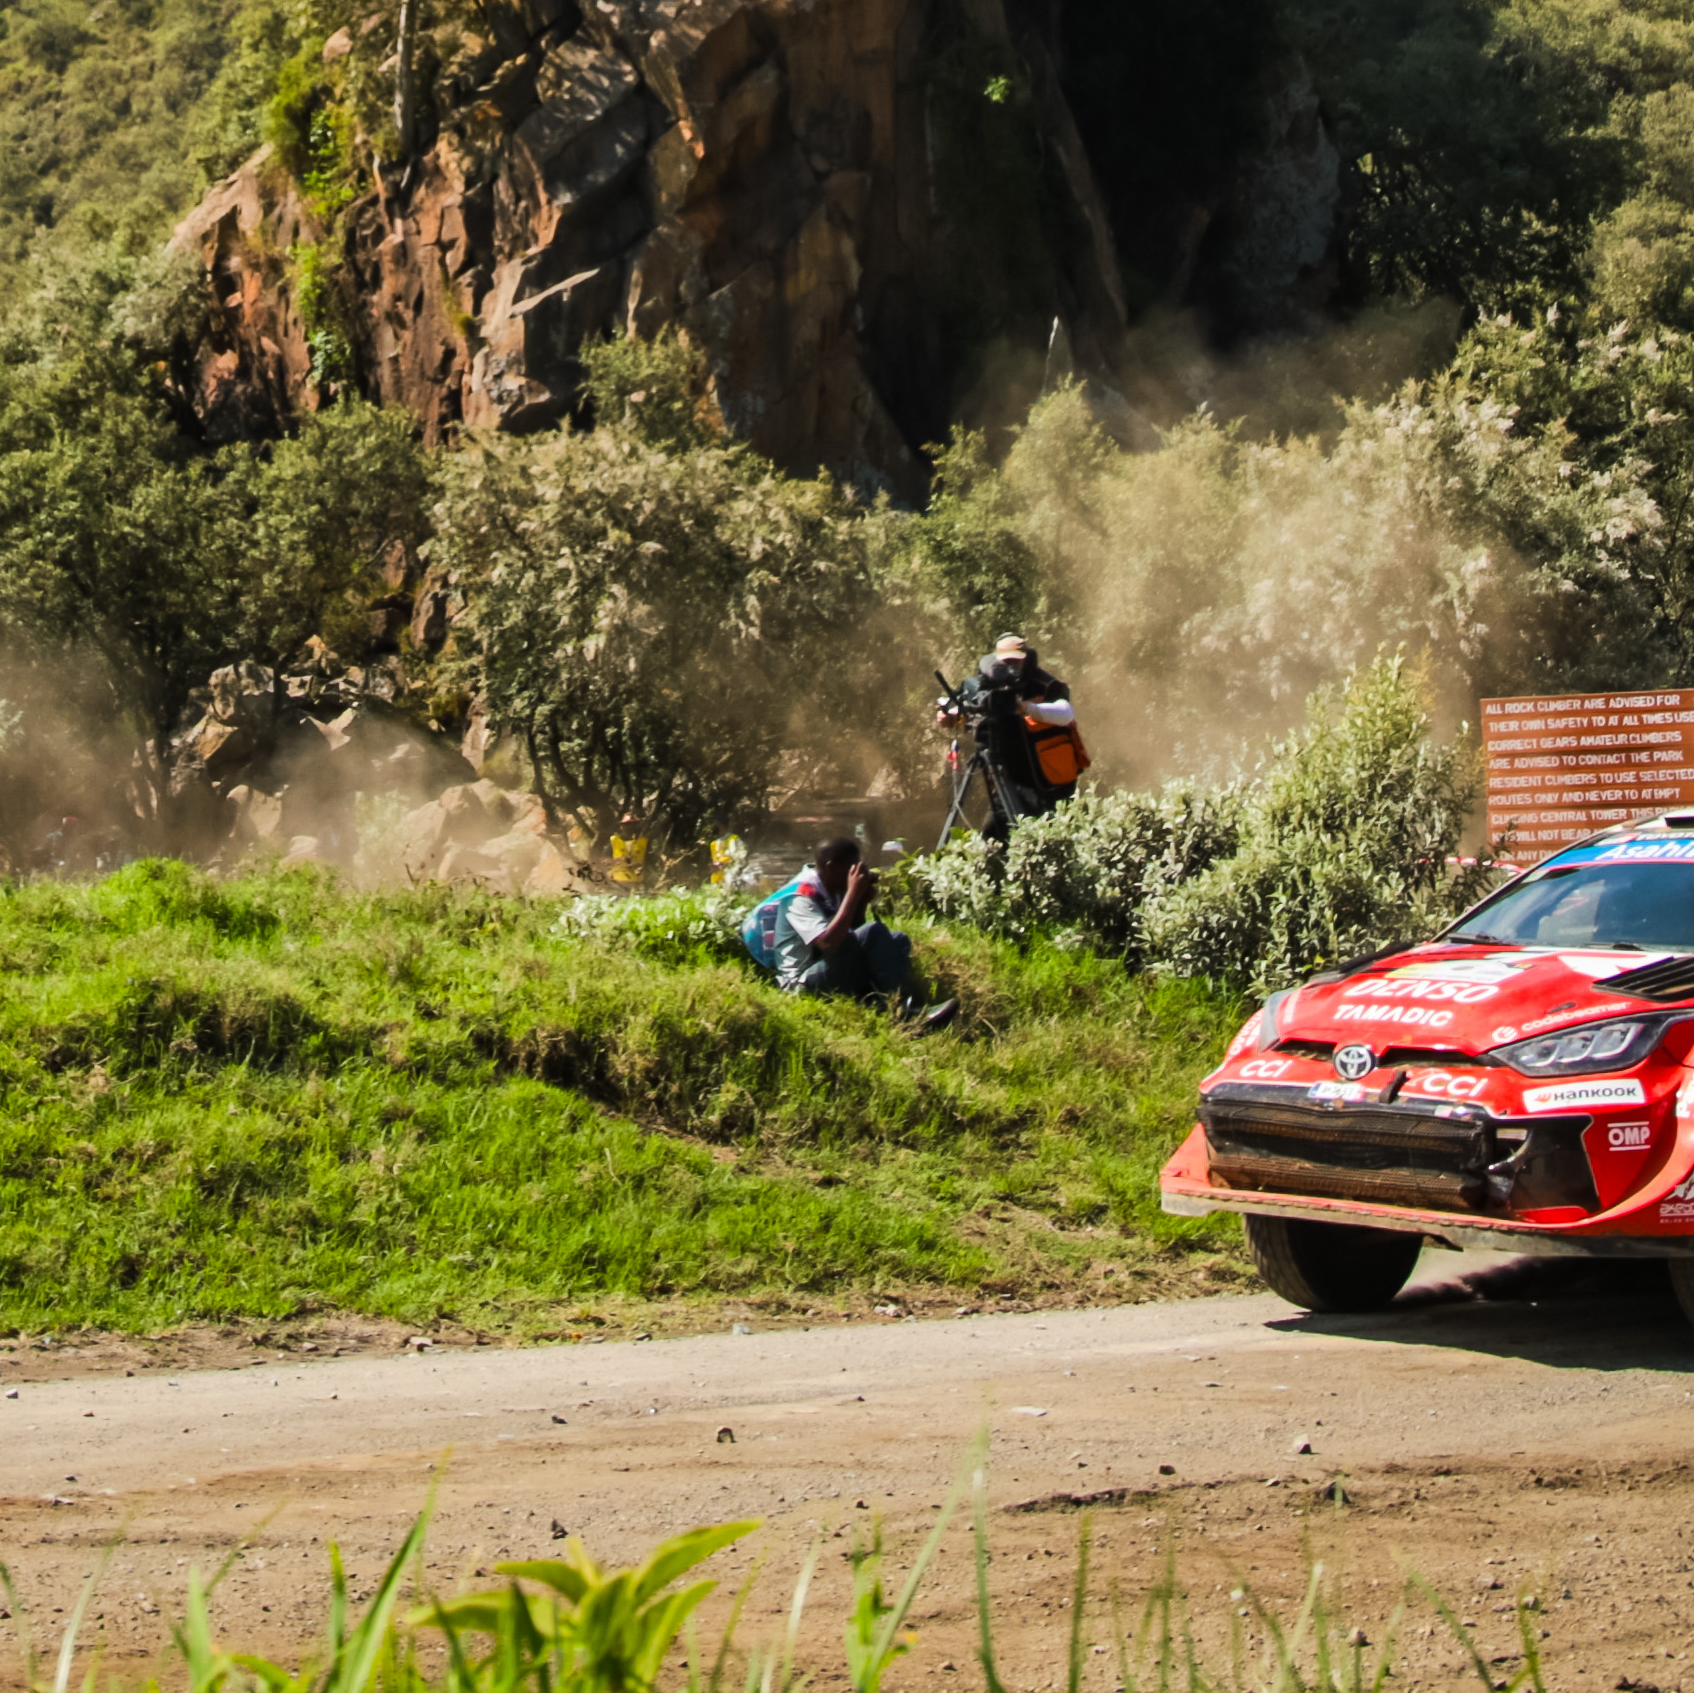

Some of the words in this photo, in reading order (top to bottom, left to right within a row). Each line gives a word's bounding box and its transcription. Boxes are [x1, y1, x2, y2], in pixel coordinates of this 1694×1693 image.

[1485, 703, 1502, 715] ALL
[1505, 702, 1535, 714] ROCK
[1537, 699, 1581, 712] CLIMBER
[1583, 697, 1606, 709] ARE
[1609, 696, 1655, 708] ADVISED
[1656, 694, 1680, 706] FOR
[1489, 721, 1519, 733] THEIR
[1521, 719, 1546, 731] OWN
[1547, 716, 1588, 729] SAFETY
[1591, 715, 1605, 727] TO
[1608, 715, 1619, 726] AT
[1623, 714, 1639, 726] ALL
[1642, 712, 1673, 724] TIMES
[1488, 738, 1537, 752] CORRECT
[1540, 736, 1578, 748] GEARS
[1580, 733, 1628, 746] AMATEUR
[1629, 731, 1682, 744] CLIMBERS
[1489, 758, 1511, 769] ARE
[1514, 756, 1560, 769] ADVISED
[1562, 755, 1577, 766] TO
[1578, 753, 1626, 766] CONTACT
[1629, 751, 1651, 763] THE
[1653, 750, 1684, 762] PARK
[1489, 775, 1542, 788] RESIDENT
[1545, 773, 1597, 786] CLIMBERS
[1599, 773, 1613, 784] TO
[1614, 771, 1637, 783] USE
[1488, 793, 1532, 805] ROUTES
[1535, 792, 1559, 804] ONLY
[1562, 791, 1584, 803] AND
[1585, 790, 1623, 801] NEVER
[1624, 789, 1638, 800] TO
[1540, 810, 1587, 823] CENTRAL
[1591, 809, 1627, 820] TOWER
[1630, 807, 1654, 819] THIS
[1516, 831, 1536, 842] WILL
[1538, 829, 1559, 841] NOT
[1561, 828, 1591, 840] BEAR
[1517, 850, 1538, 861] ANY
[1344, 978, 1501, 1003] DENSO
[1333, 1004, 1454, 1028] TAMADIC
[1520, 1000, 1633, 1033] codebeamer
[1608, 1127, 1650, 1146] OMP
